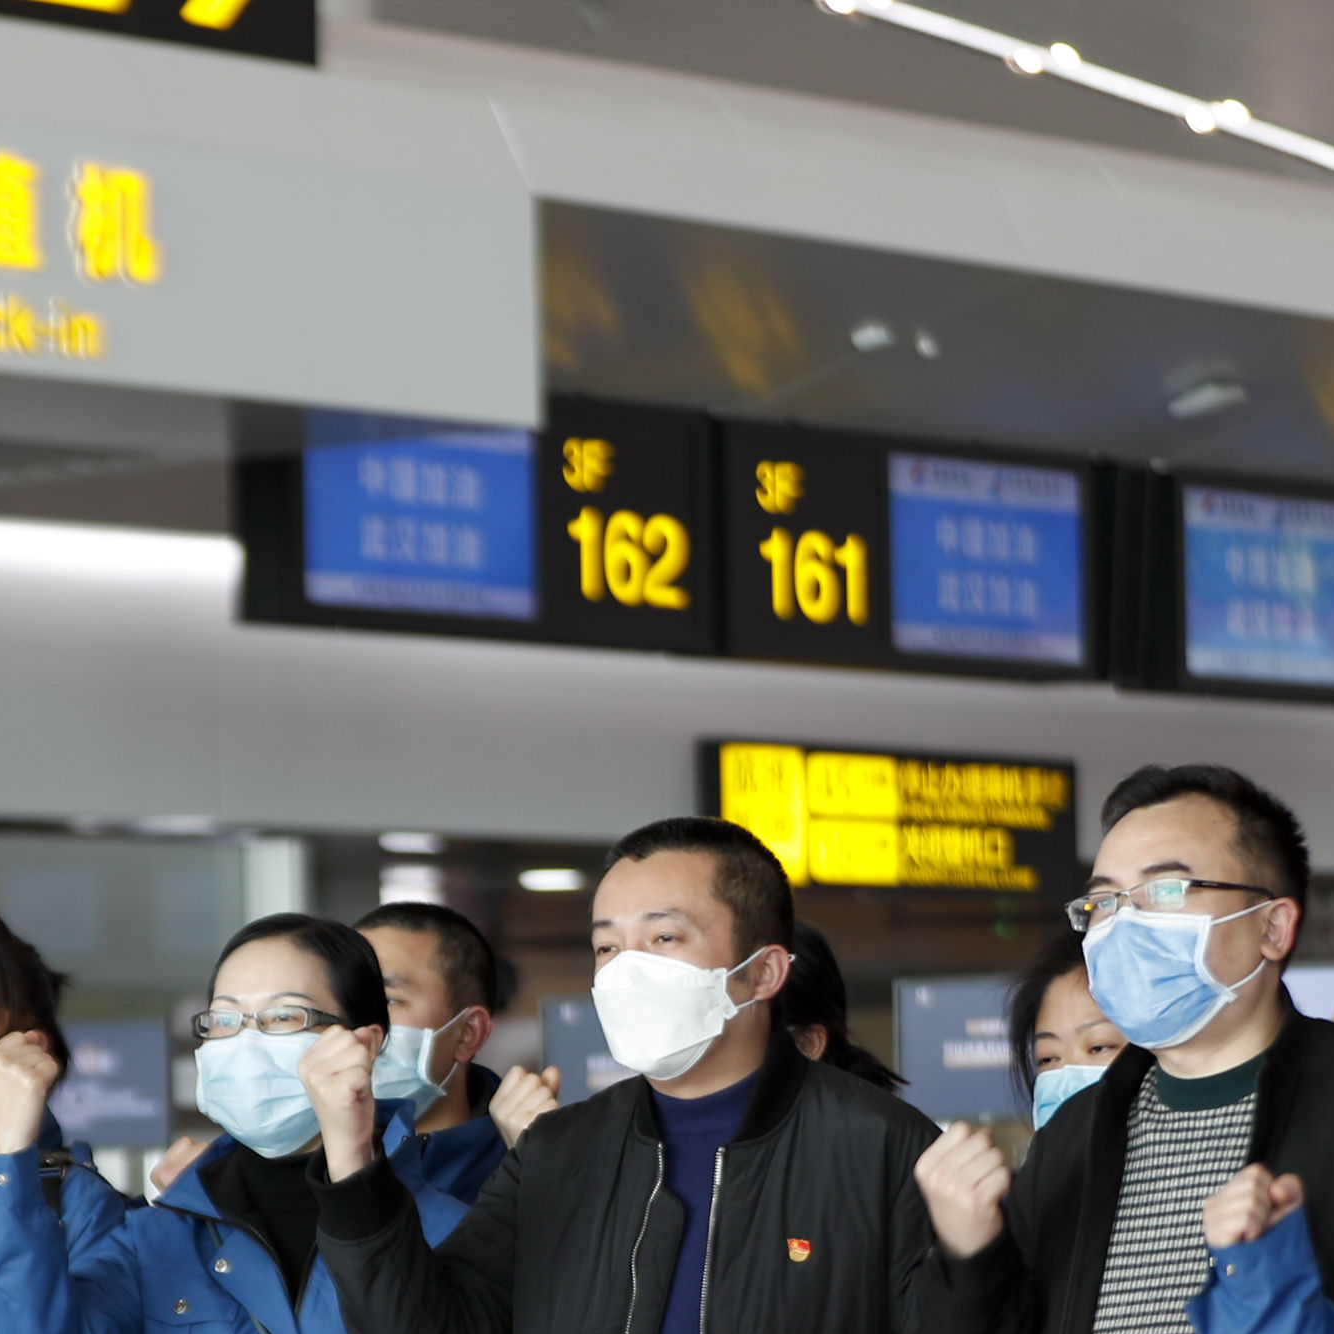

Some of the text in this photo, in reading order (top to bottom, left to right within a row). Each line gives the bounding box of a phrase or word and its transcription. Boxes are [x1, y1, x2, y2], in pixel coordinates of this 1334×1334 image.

[561, 437, 614, 493] 3F
[753, 460, 805, 514] 3F
[565, 504, 691, 612] 162
[757, 525, 869, 626] 161
